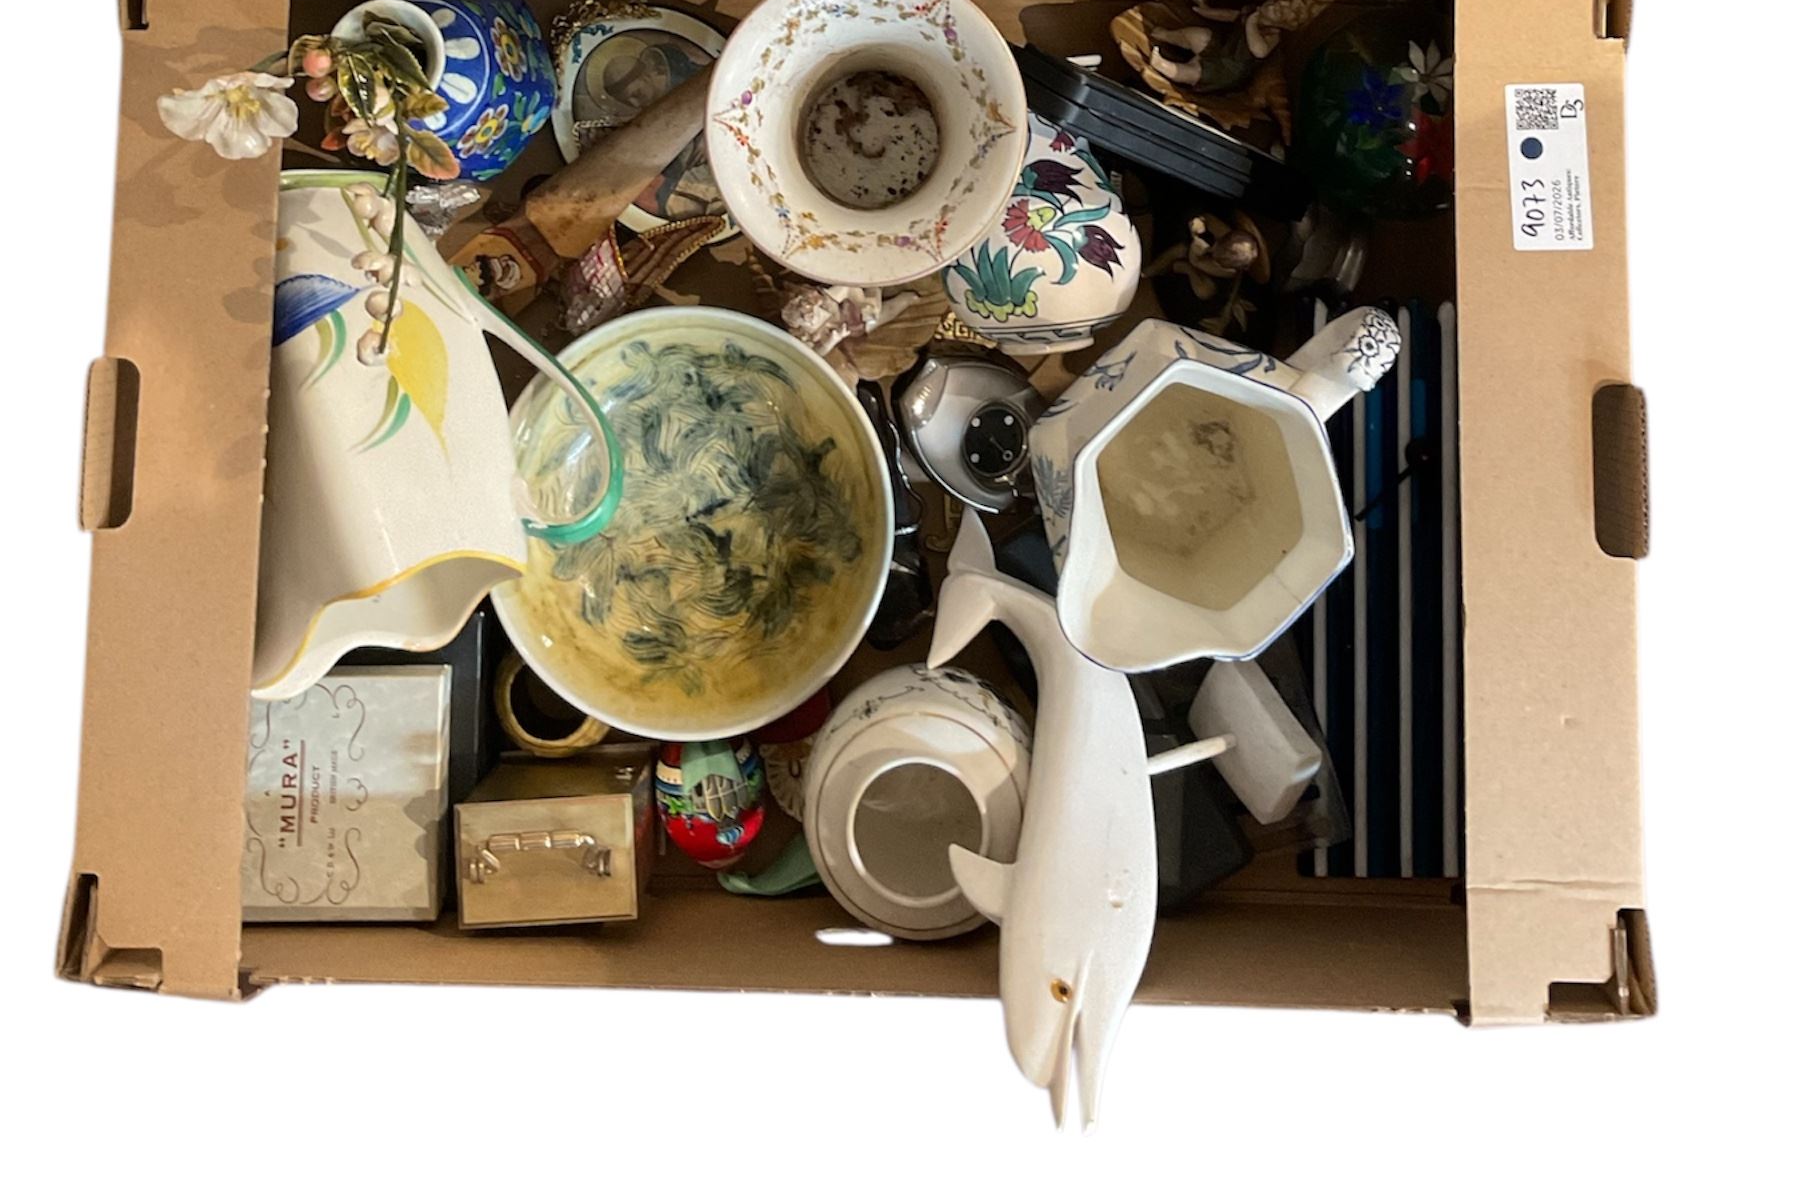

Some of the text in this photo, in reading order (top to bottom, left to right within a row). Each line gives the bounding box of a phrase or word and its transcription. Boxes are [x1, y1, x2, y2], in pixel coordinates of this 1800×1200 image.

[1520, 178, 1547, 237] 9073
[1551, 179, 1565, 241] 03/07/2026
[309, 764, 321, 825] PRODUCT
